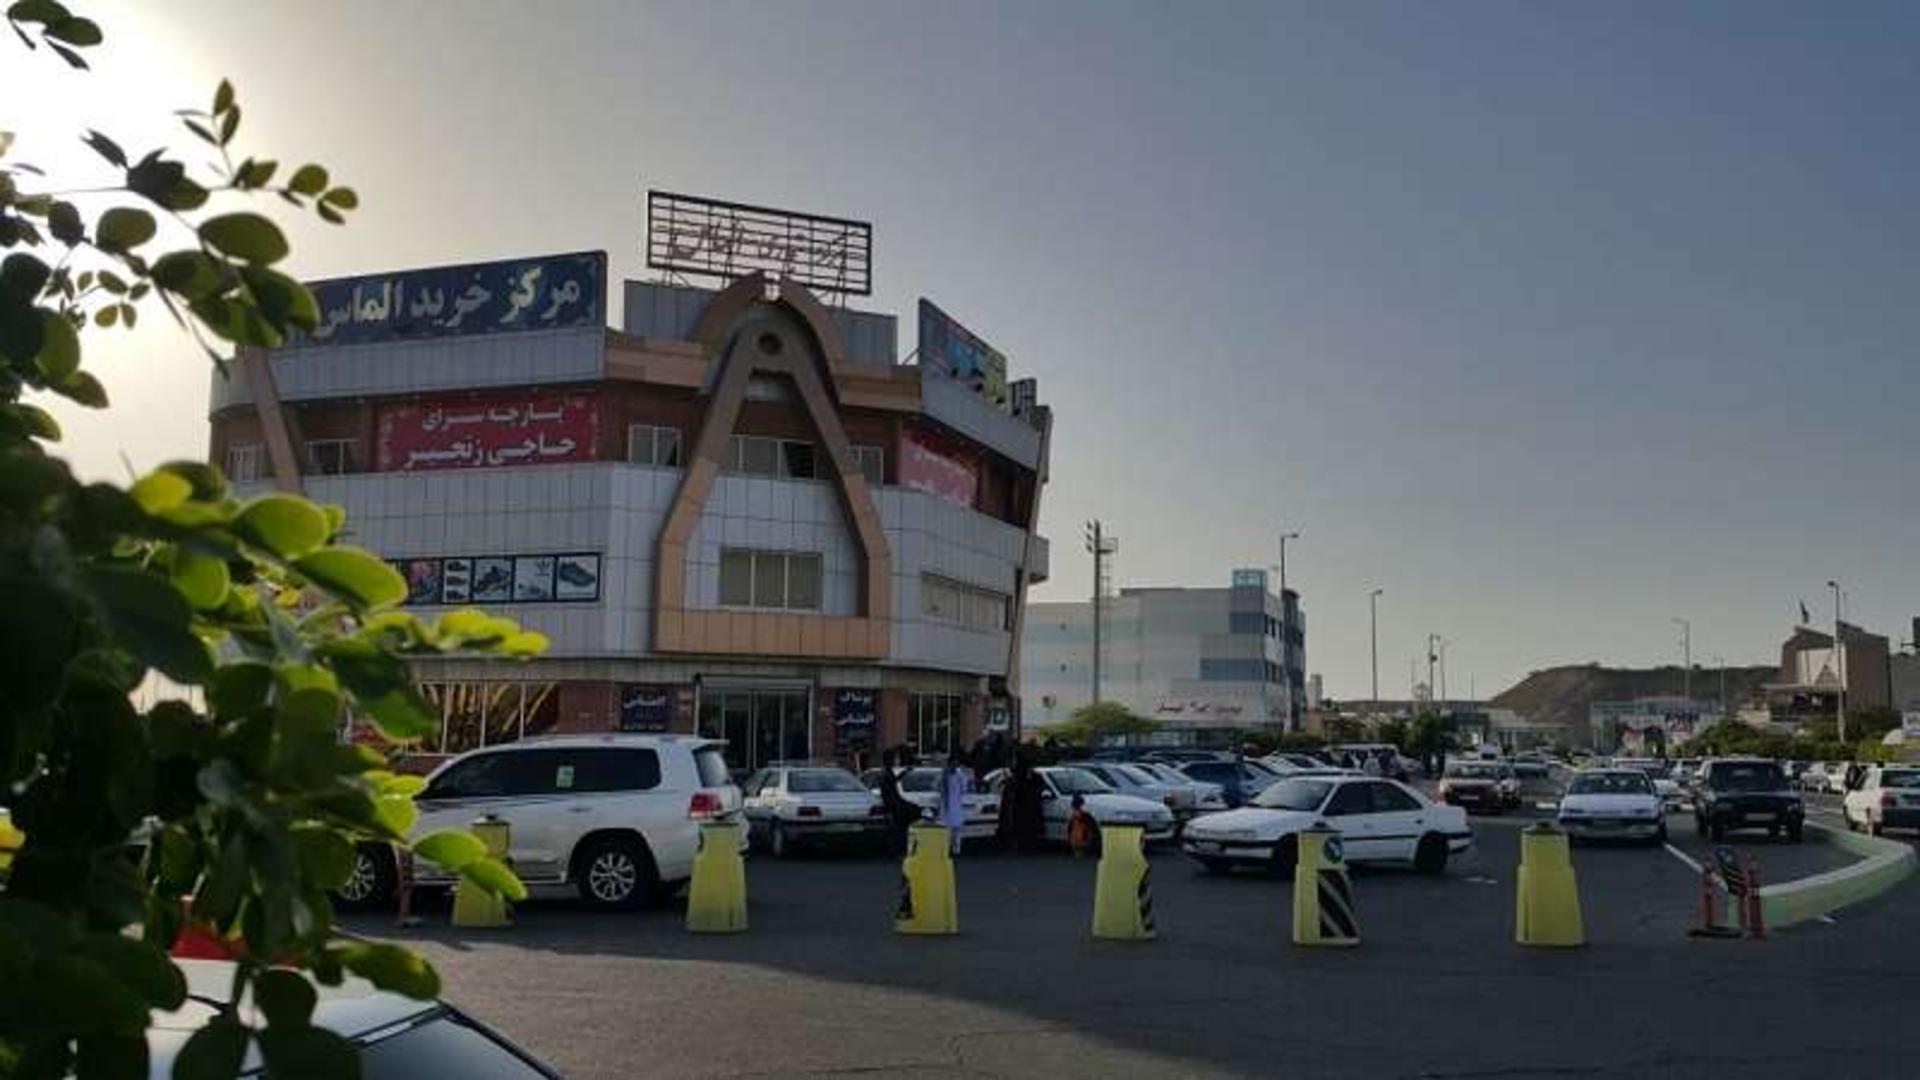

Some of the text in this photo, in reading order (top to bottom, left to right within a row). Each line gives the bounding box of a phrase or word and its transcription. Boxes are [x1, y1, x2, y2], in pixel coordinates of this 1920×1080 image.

[312, 265, 581, 339] مرکز خرید الماس
[488, 431, 577, 465] حاجی
